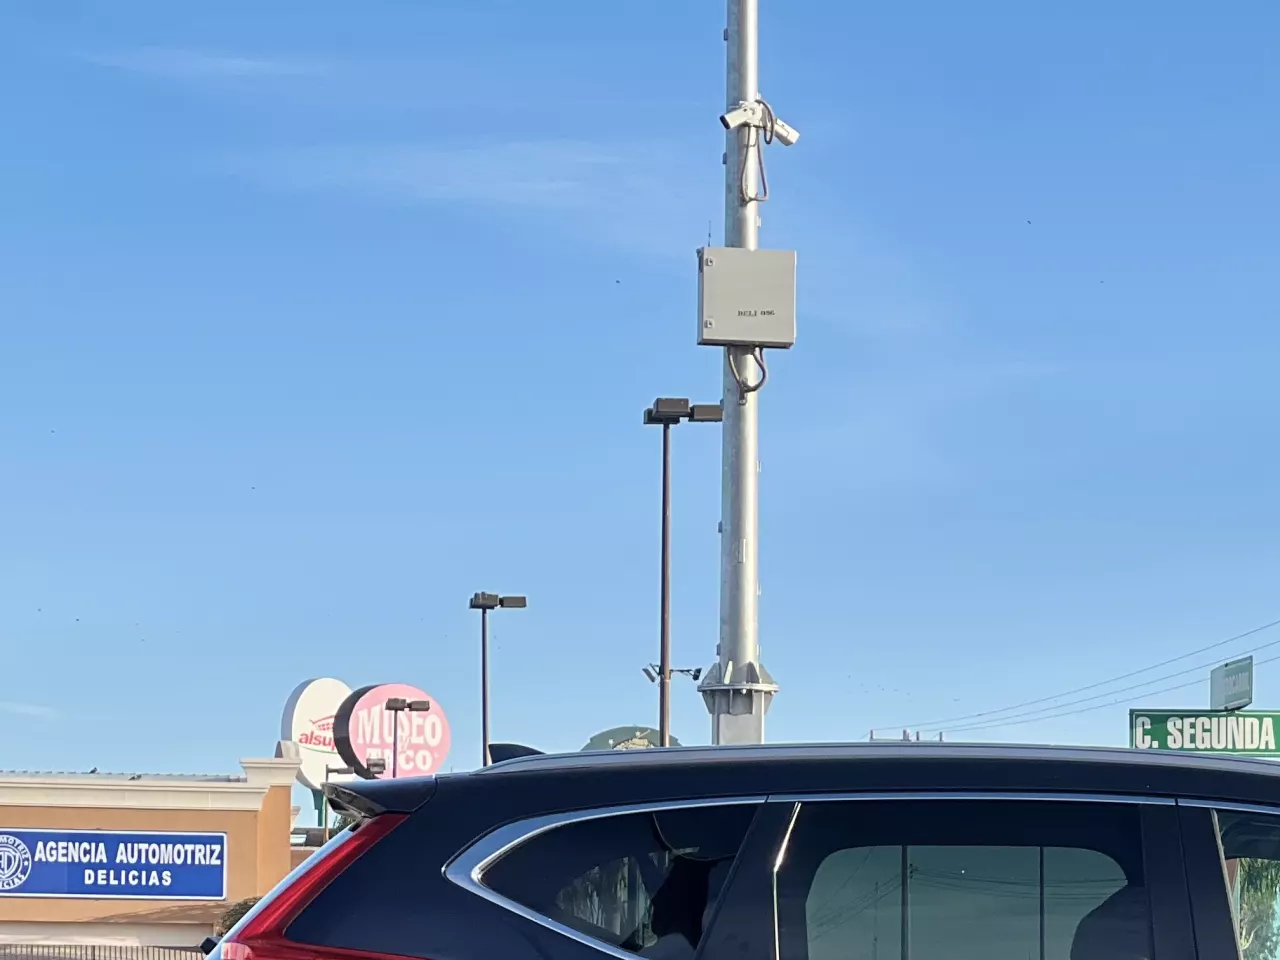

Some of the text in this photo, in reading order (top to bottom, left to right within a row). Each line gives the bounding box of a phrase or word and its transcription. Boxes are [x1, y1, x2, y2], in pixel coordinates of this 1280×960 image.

[1135, 716, 1159, 750] C.
[1166, 716, 1276, 750] SEGUNDA
[34, 840, 222, 865] AGENCIA AUTOMOTRIZ
[84, 869, 172, 886] DELICIAS
